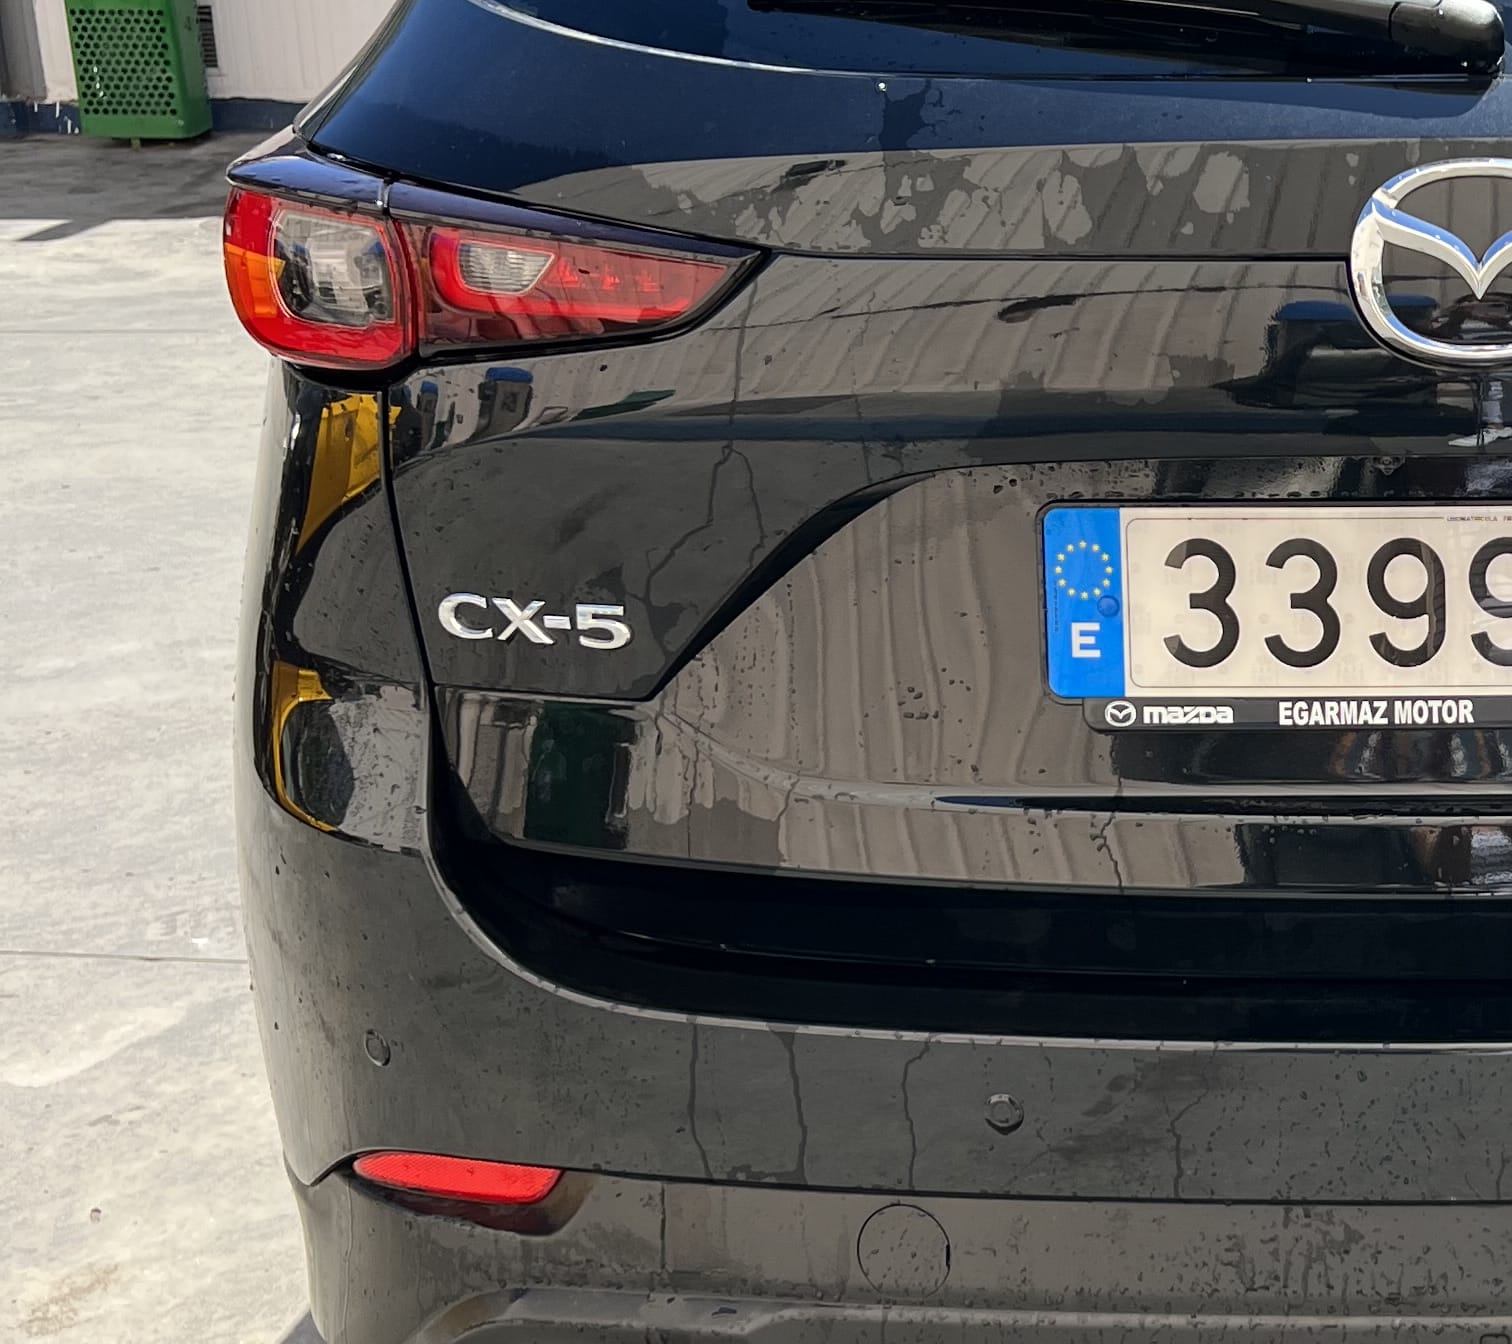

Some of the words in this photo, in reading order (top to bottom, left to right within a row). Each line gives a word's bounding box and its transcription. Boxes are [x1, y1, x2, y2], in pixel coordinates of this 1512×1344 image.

[438, 592, 631, 650] CX-5
[1071, 622, 1101, 658] E
[1278, 700, 1388, 726] EGARMAZ
[1394, 699, 1475, 724] MOTOR
